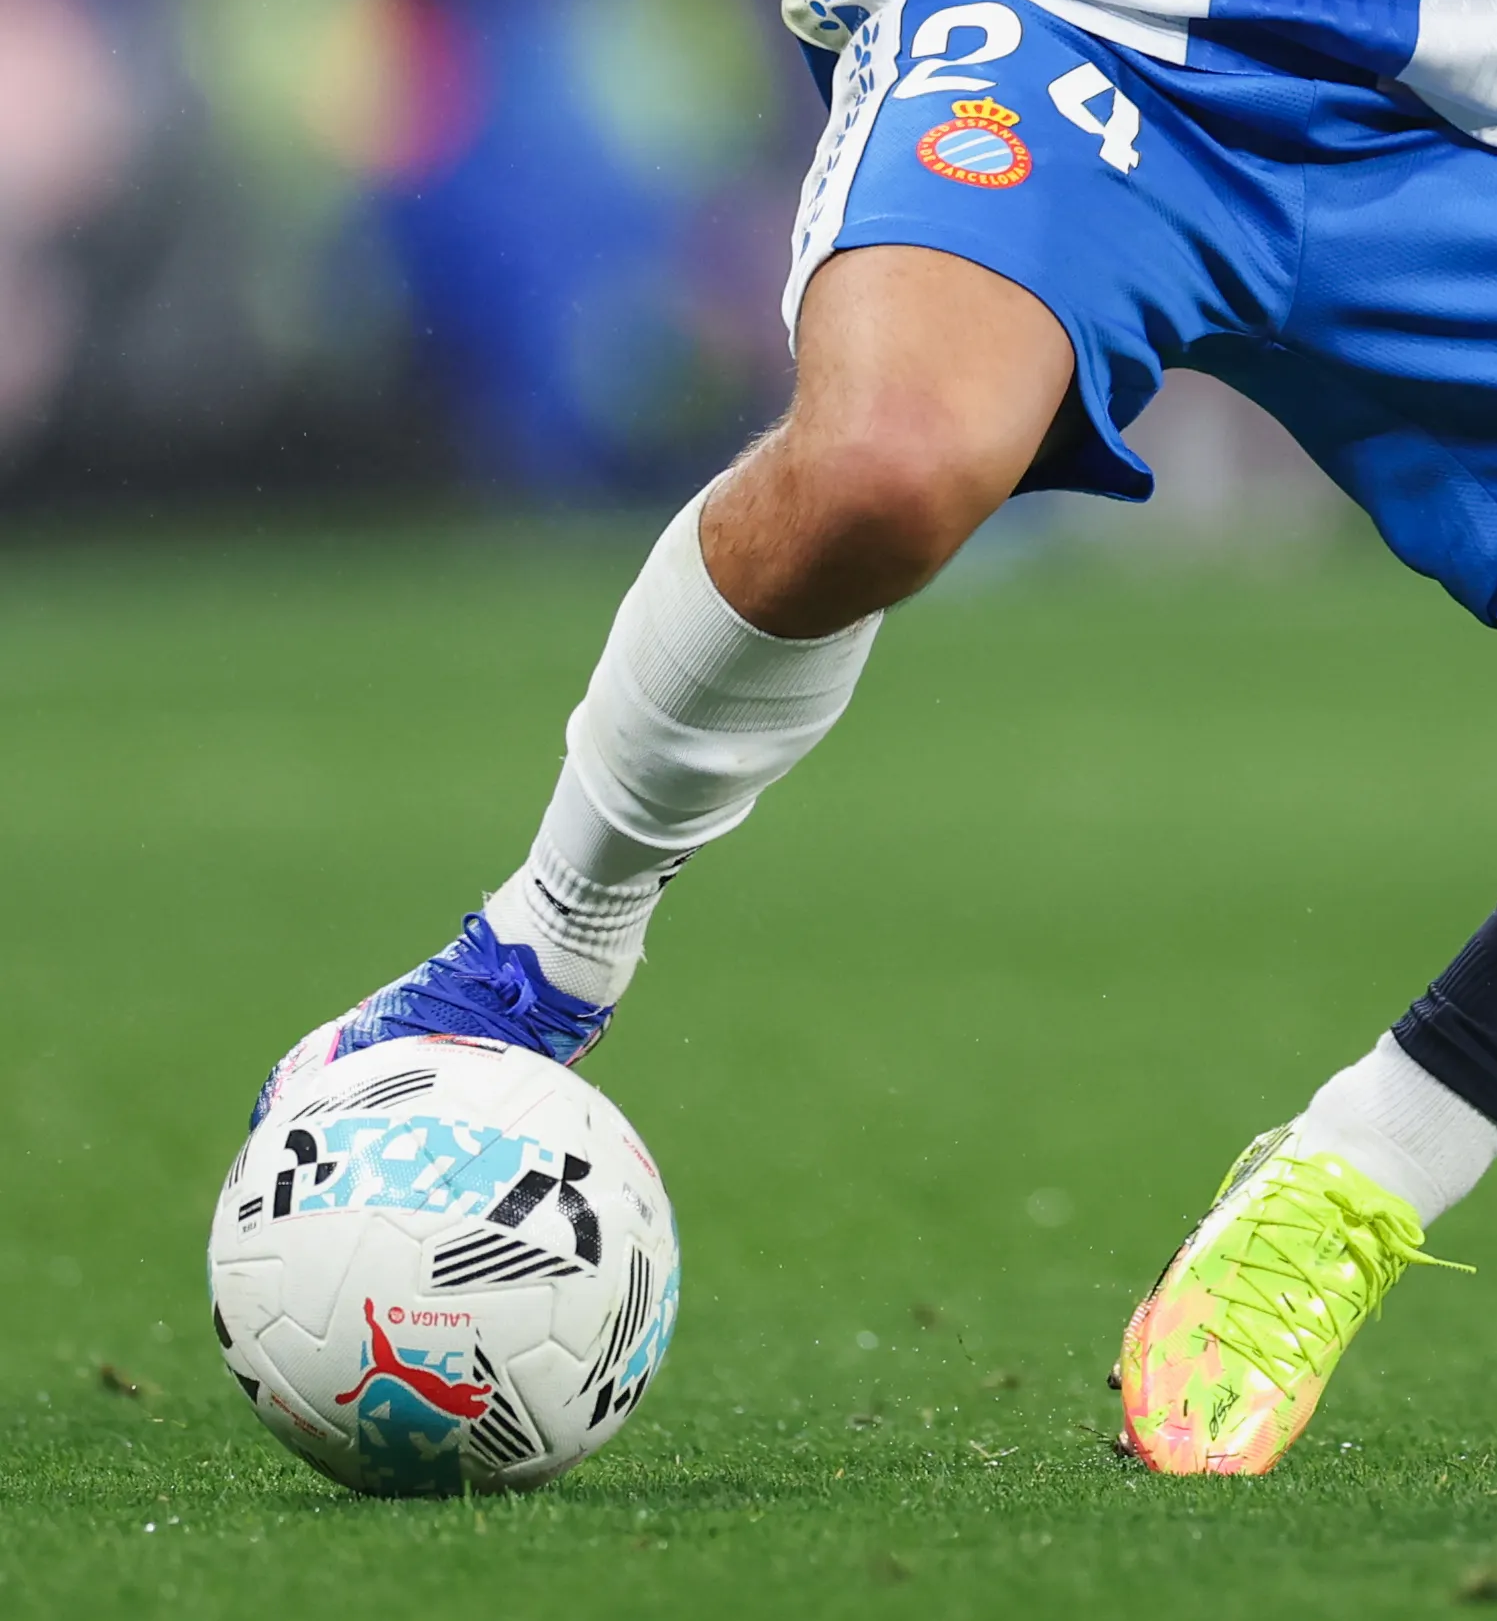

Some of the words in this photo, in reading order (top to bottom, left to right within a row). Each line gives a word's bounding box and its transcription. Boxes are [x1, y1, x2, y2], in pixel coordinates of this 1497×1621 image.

[890, 2, 1141, 175] 24
[955, 119, 1028, 161] ESPANYOL
[933, 162, 1026, 185] BARCELONA
[411, 1309, 471, 1327] LALIGA
